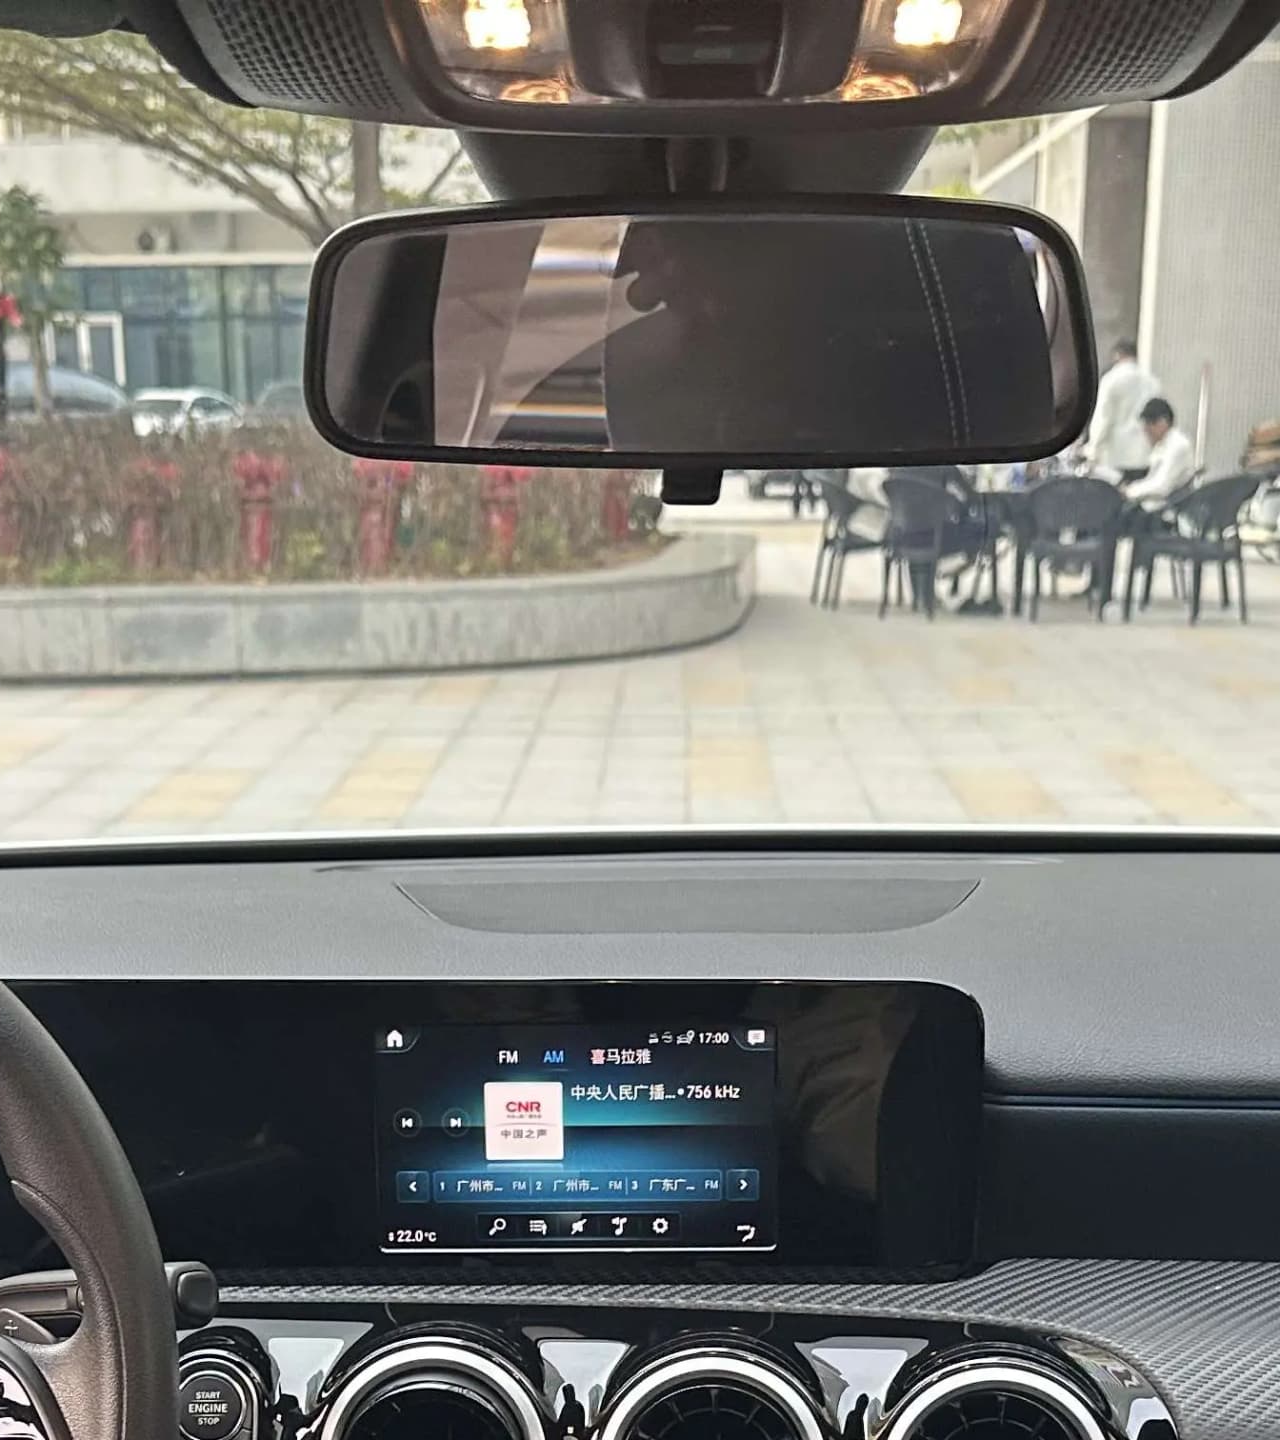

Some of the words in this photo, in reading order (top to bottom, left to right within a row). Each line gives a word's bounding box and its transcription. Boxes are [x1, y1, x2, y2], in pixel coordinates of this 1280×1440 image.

[698, 1032, 730, 1044] 17:00
[498, 1050, 519, 1064] FM
[543, 1050, 564, 1063] AM
[590, 1048, 652, 1065] 喜马拉雅
[686, 1085, 712, 1099] 756
[714, 1085, 741, 1099] kHz
[505, 1101, 542, 1113] CNR
[500, 1128, 548, 1139] 中国之声
[439, 1181, 446, 1191] 1
[512, 1181, 527, 1191] FM
[535, 1181, 543, 1191] 2
[608, 1180, 623, 1190] FM
[631, 1180, 639, 1190] 3
[704, 1180, 719, 1190] FM
[195, 1391, 221, 1400] START
[188, 1403, 229, 1413] ENGINE
[197, 1417, 220, 1425] STOP
